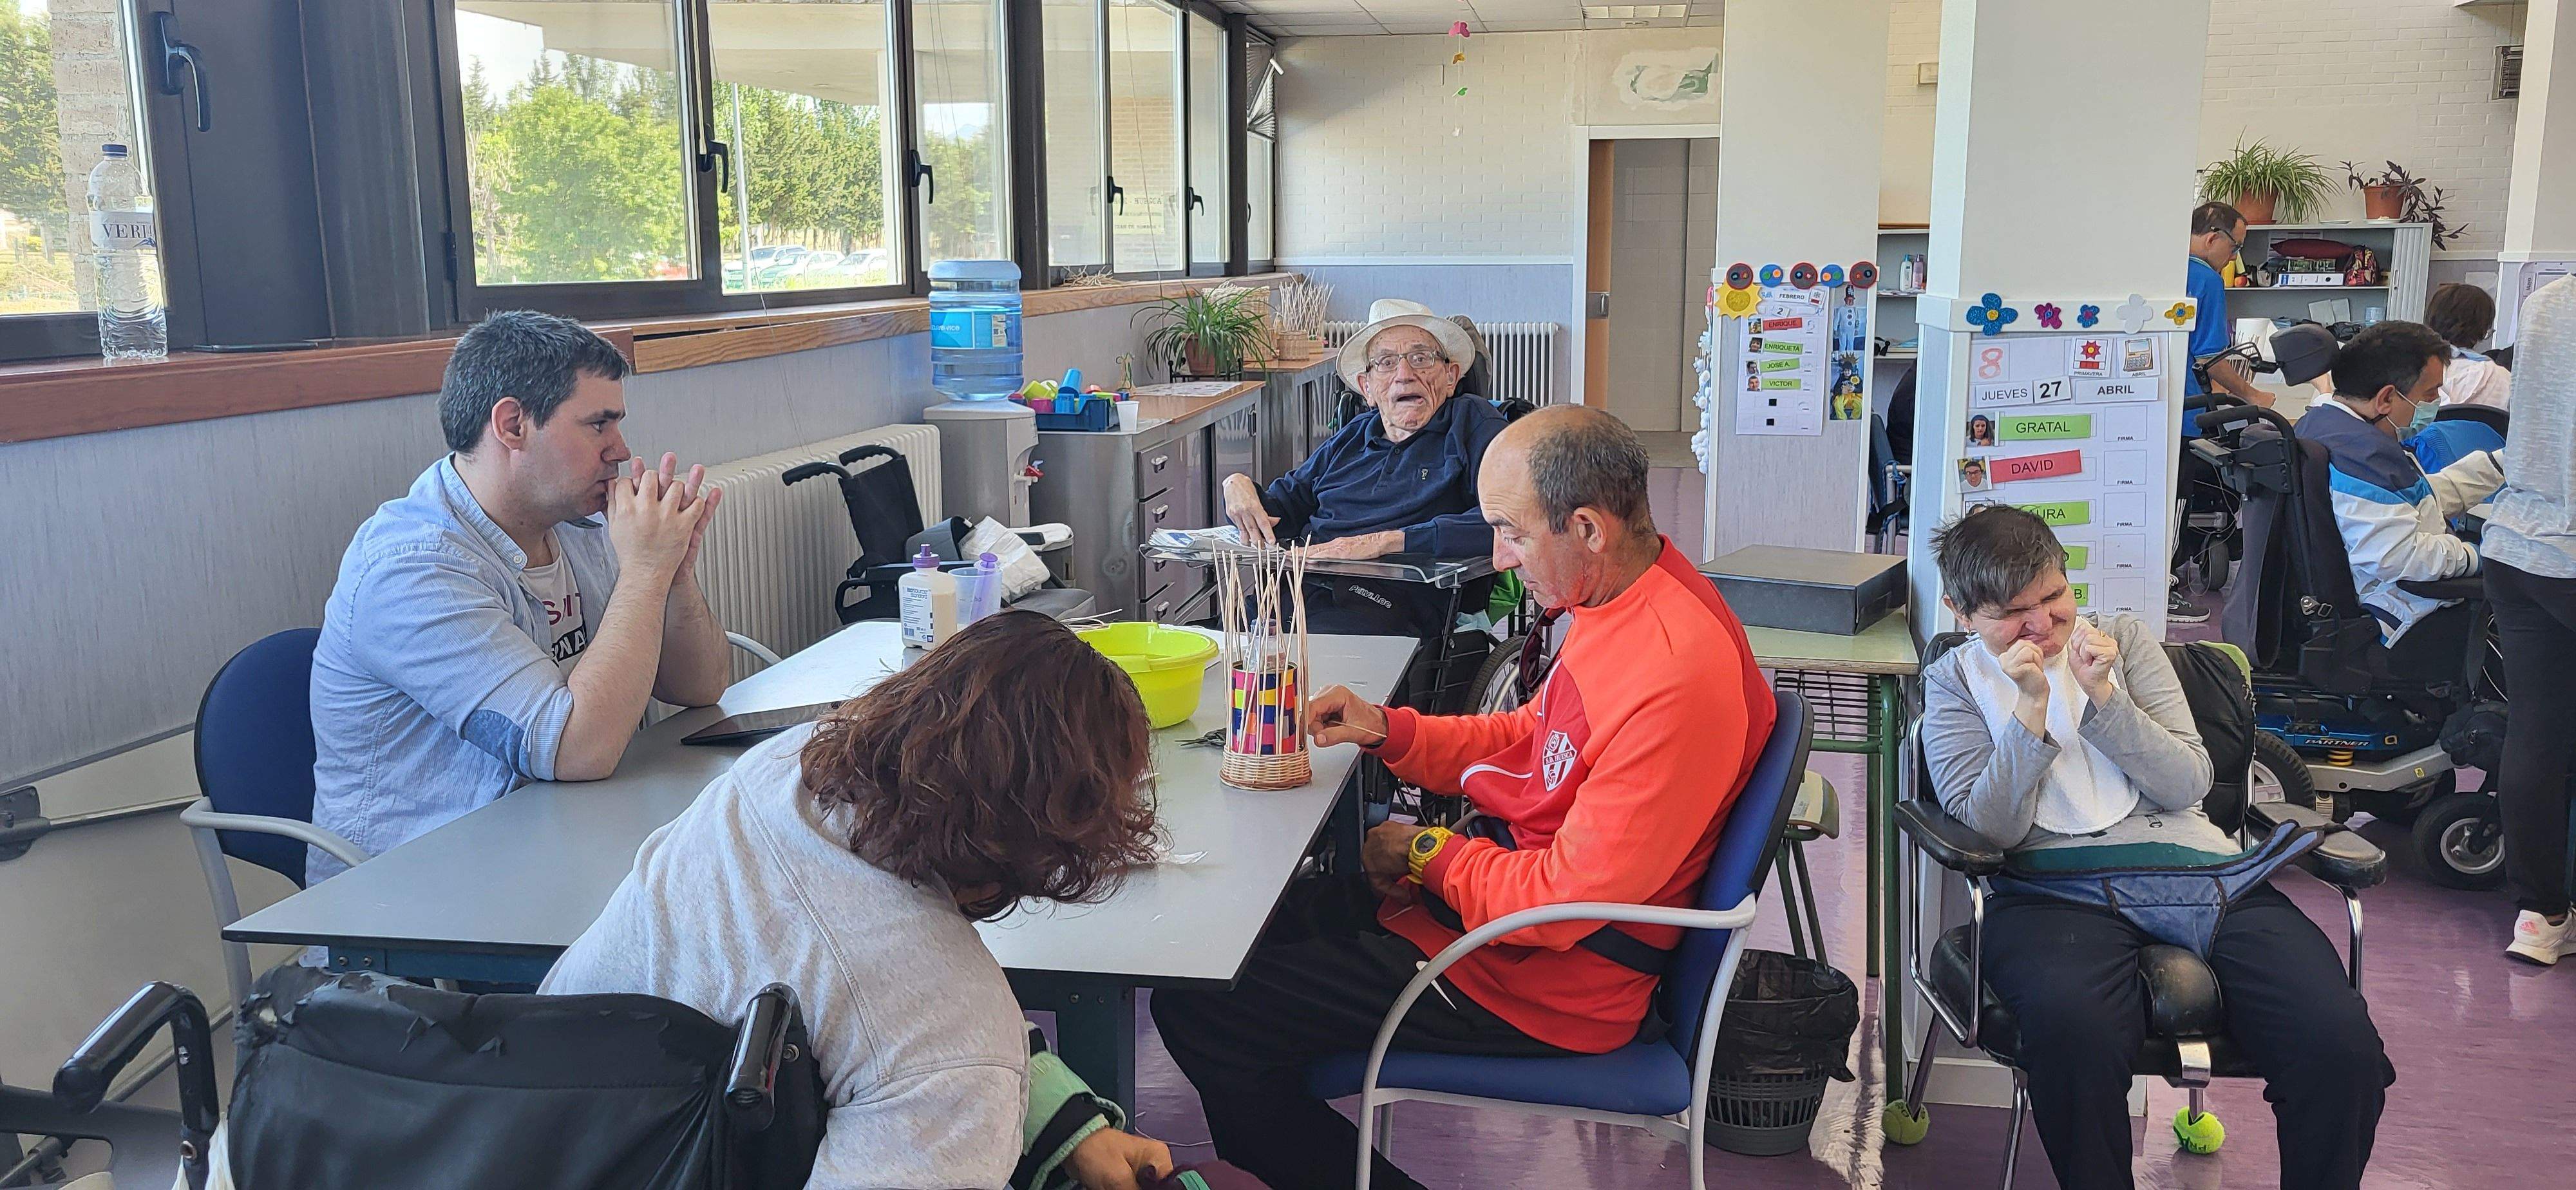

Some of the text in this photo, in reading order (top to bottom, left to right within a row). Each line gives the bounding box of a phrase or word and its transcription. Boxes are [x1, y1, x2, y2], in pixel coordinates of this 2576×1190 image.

[1768, 320, 1797, 328] ENRIQUE
[1764, 343, 1800, 352] ENRIQUETA
[1982, 381, 2135, 401] JUEVES 27 ABRIL
[2016, 421, 2071, 433] GRATAL
[2011, 459, 2054, 475] DAVID
[1554, 751, 1573, 762] HUESCA
